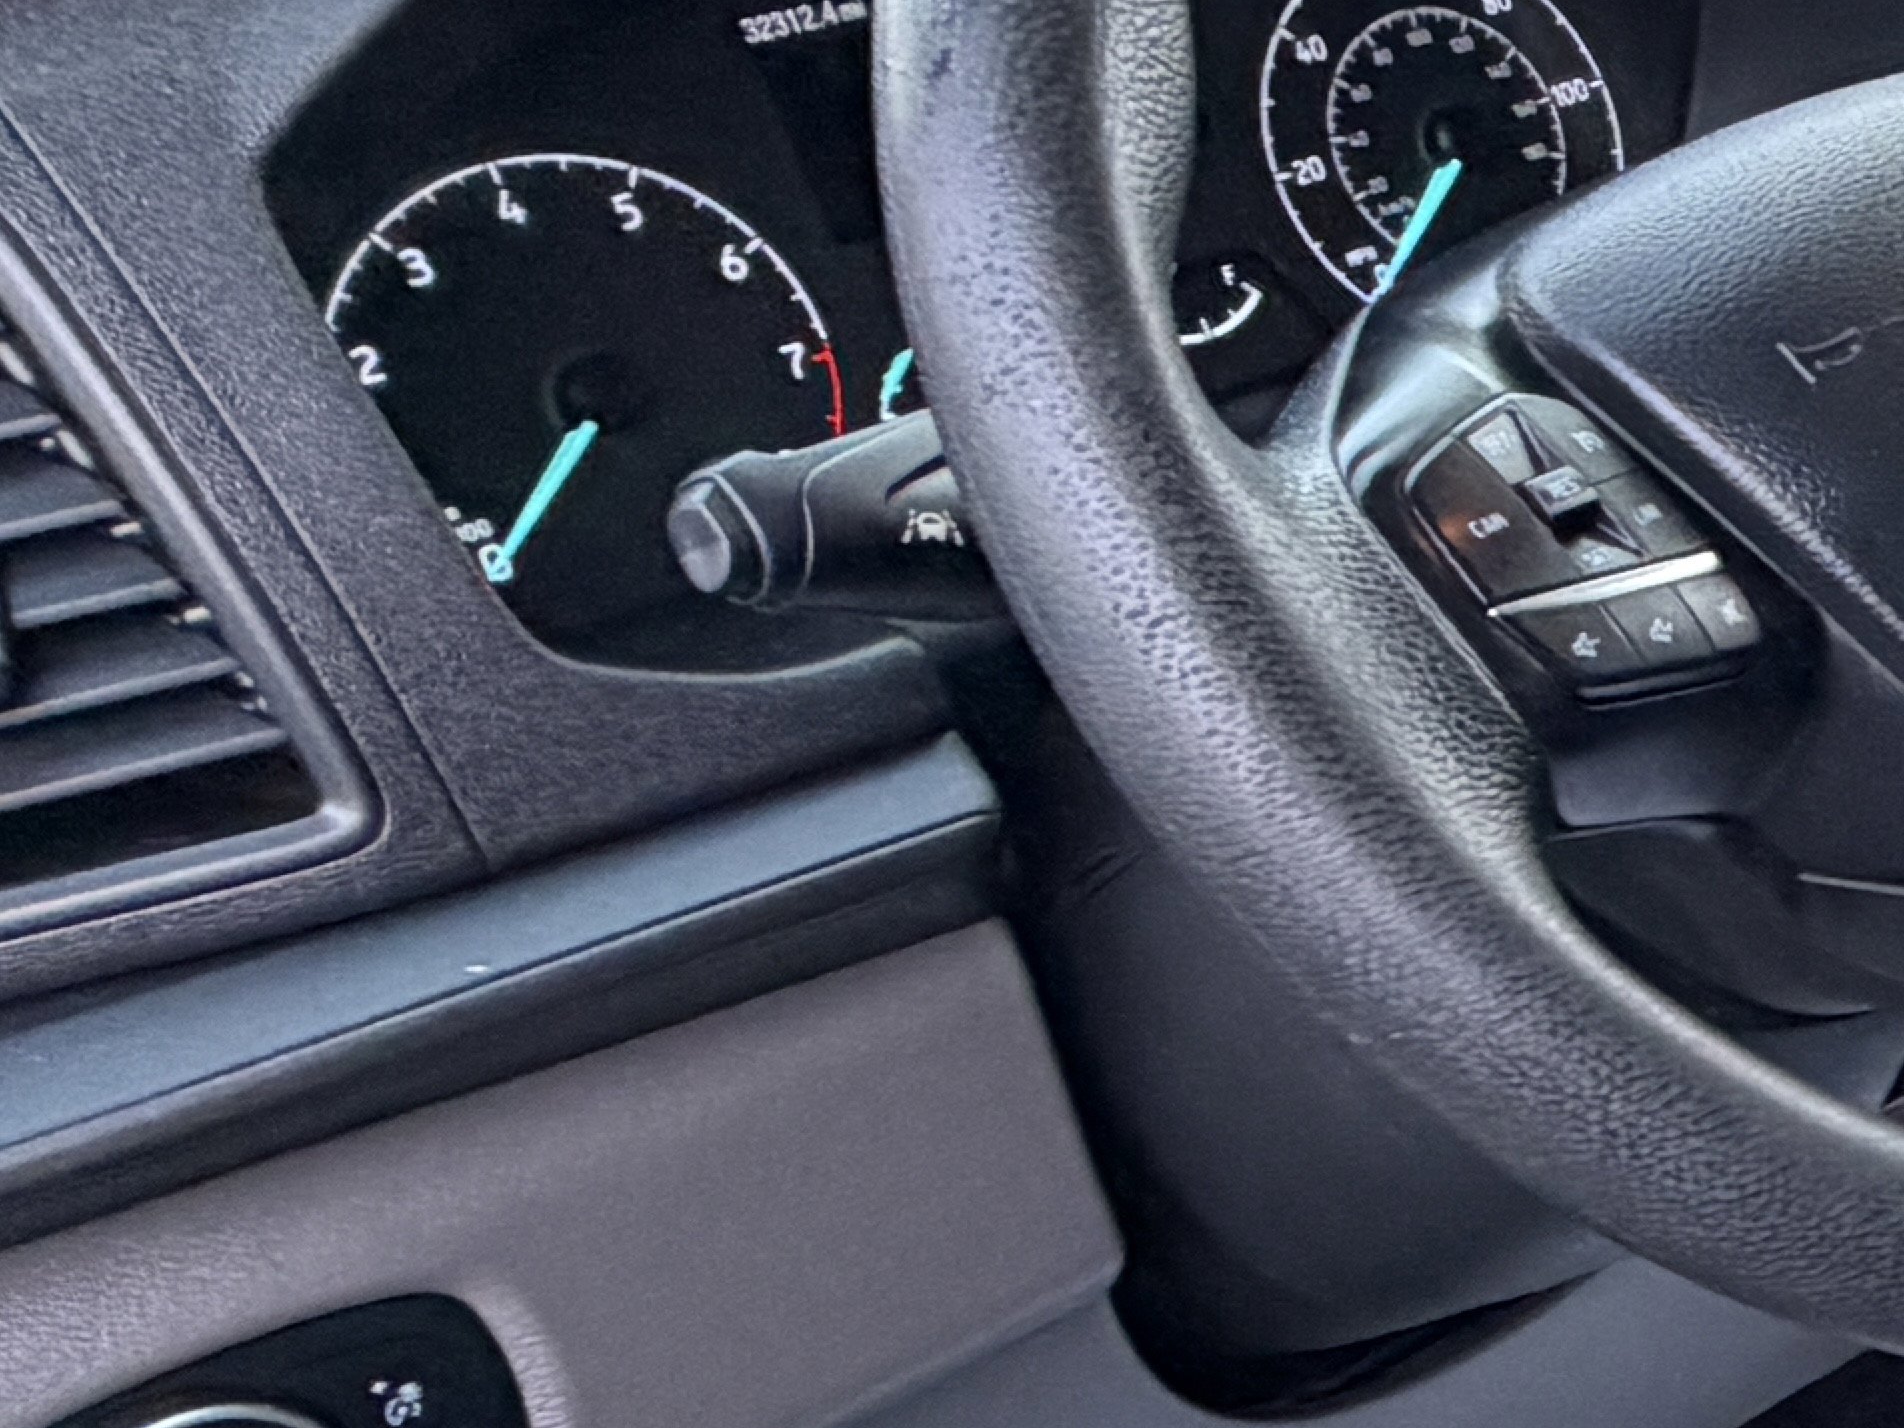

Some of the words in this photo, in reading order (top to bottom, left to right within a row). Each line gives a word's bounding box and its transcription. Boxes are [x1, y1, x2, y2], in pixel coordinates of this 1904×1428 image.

[1295, 34, 1327, 62] 40
[1552, 78, 1589, 107] 100
[1292, 155, 1327, 185] 20
[497, 191, 526, 225] 4
[612, 192, 643, 231] 5
[400, 249, 434, 286] 3
[720, 243, 750, 281] 6
[349, 344, 386, 384] 2
[778, 344, 806, 378] 7
